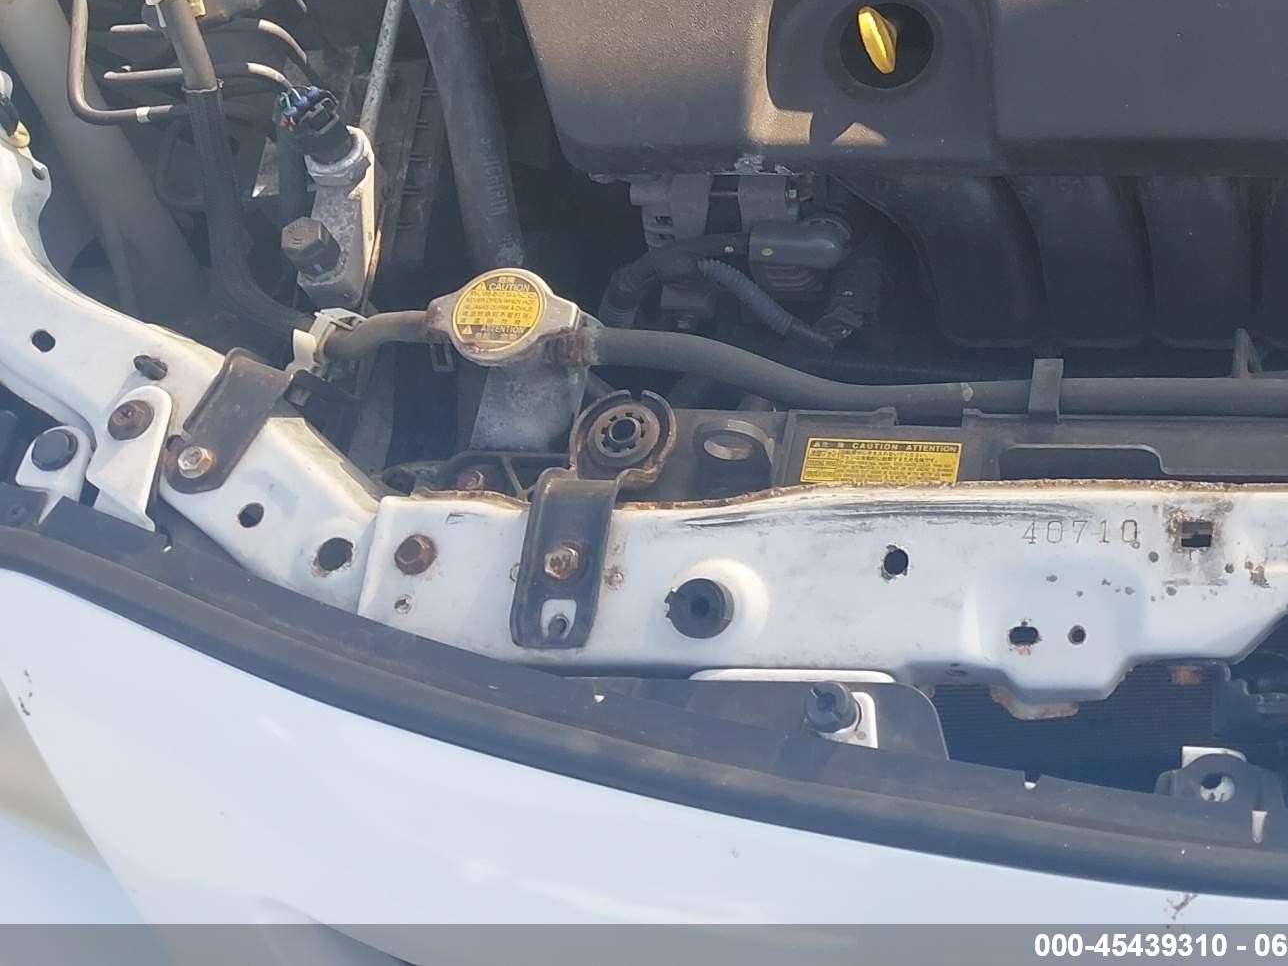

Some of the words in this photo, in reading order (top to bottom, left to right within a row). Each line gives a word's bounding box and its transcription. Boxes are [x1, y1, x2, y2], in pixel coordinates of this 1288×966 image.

[489, 282, 530, 292] CAUTION
[852, 442, 898, 451] CAUTION
[905, 444, 957, 452] ATTENTION
